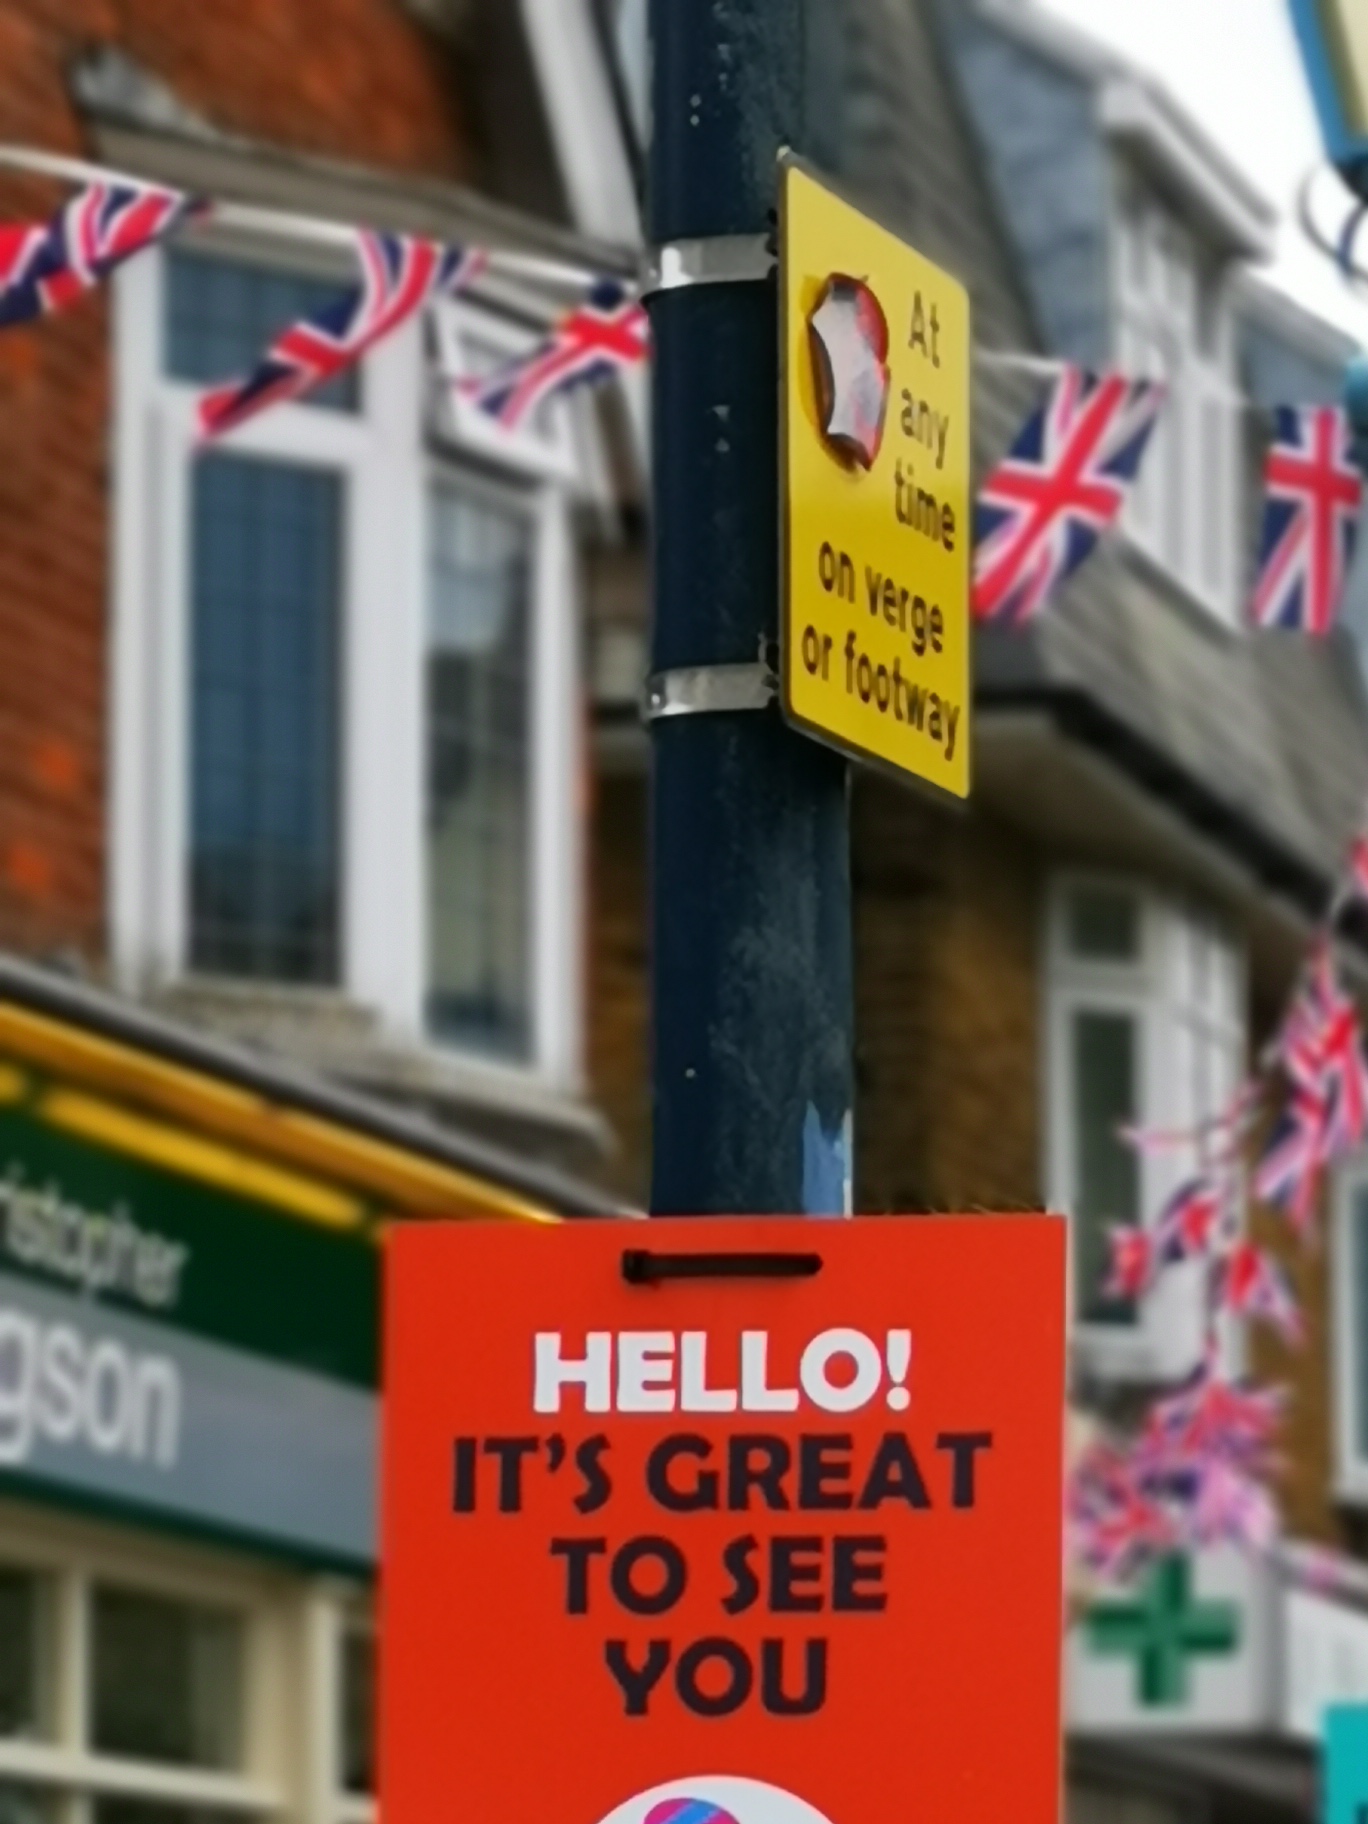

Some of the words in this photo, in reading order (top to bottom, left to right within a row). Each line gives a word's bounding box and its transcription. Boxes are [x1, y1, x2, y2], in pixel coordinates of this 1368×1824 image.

[908, 291, 941, 368] At
[900, 387, 950, 469] any
[893, 458, 955, 552] time
[818, 541, 856, 604] on
[865, 562, 944, 657] verge
[801, 624, 833, 680] or
[845, 630, 960, 762] footway
[534, 1328, 911, 1413] HELLO!
[452, 1433, 612, 1514] IT'S
[646, 1431, 993, 1512] GREAT
[550, 1535, 687, 1614] TO
[721, 1533, 888, 1614] SEE
[604, 1637, 828, 1716] YOU
